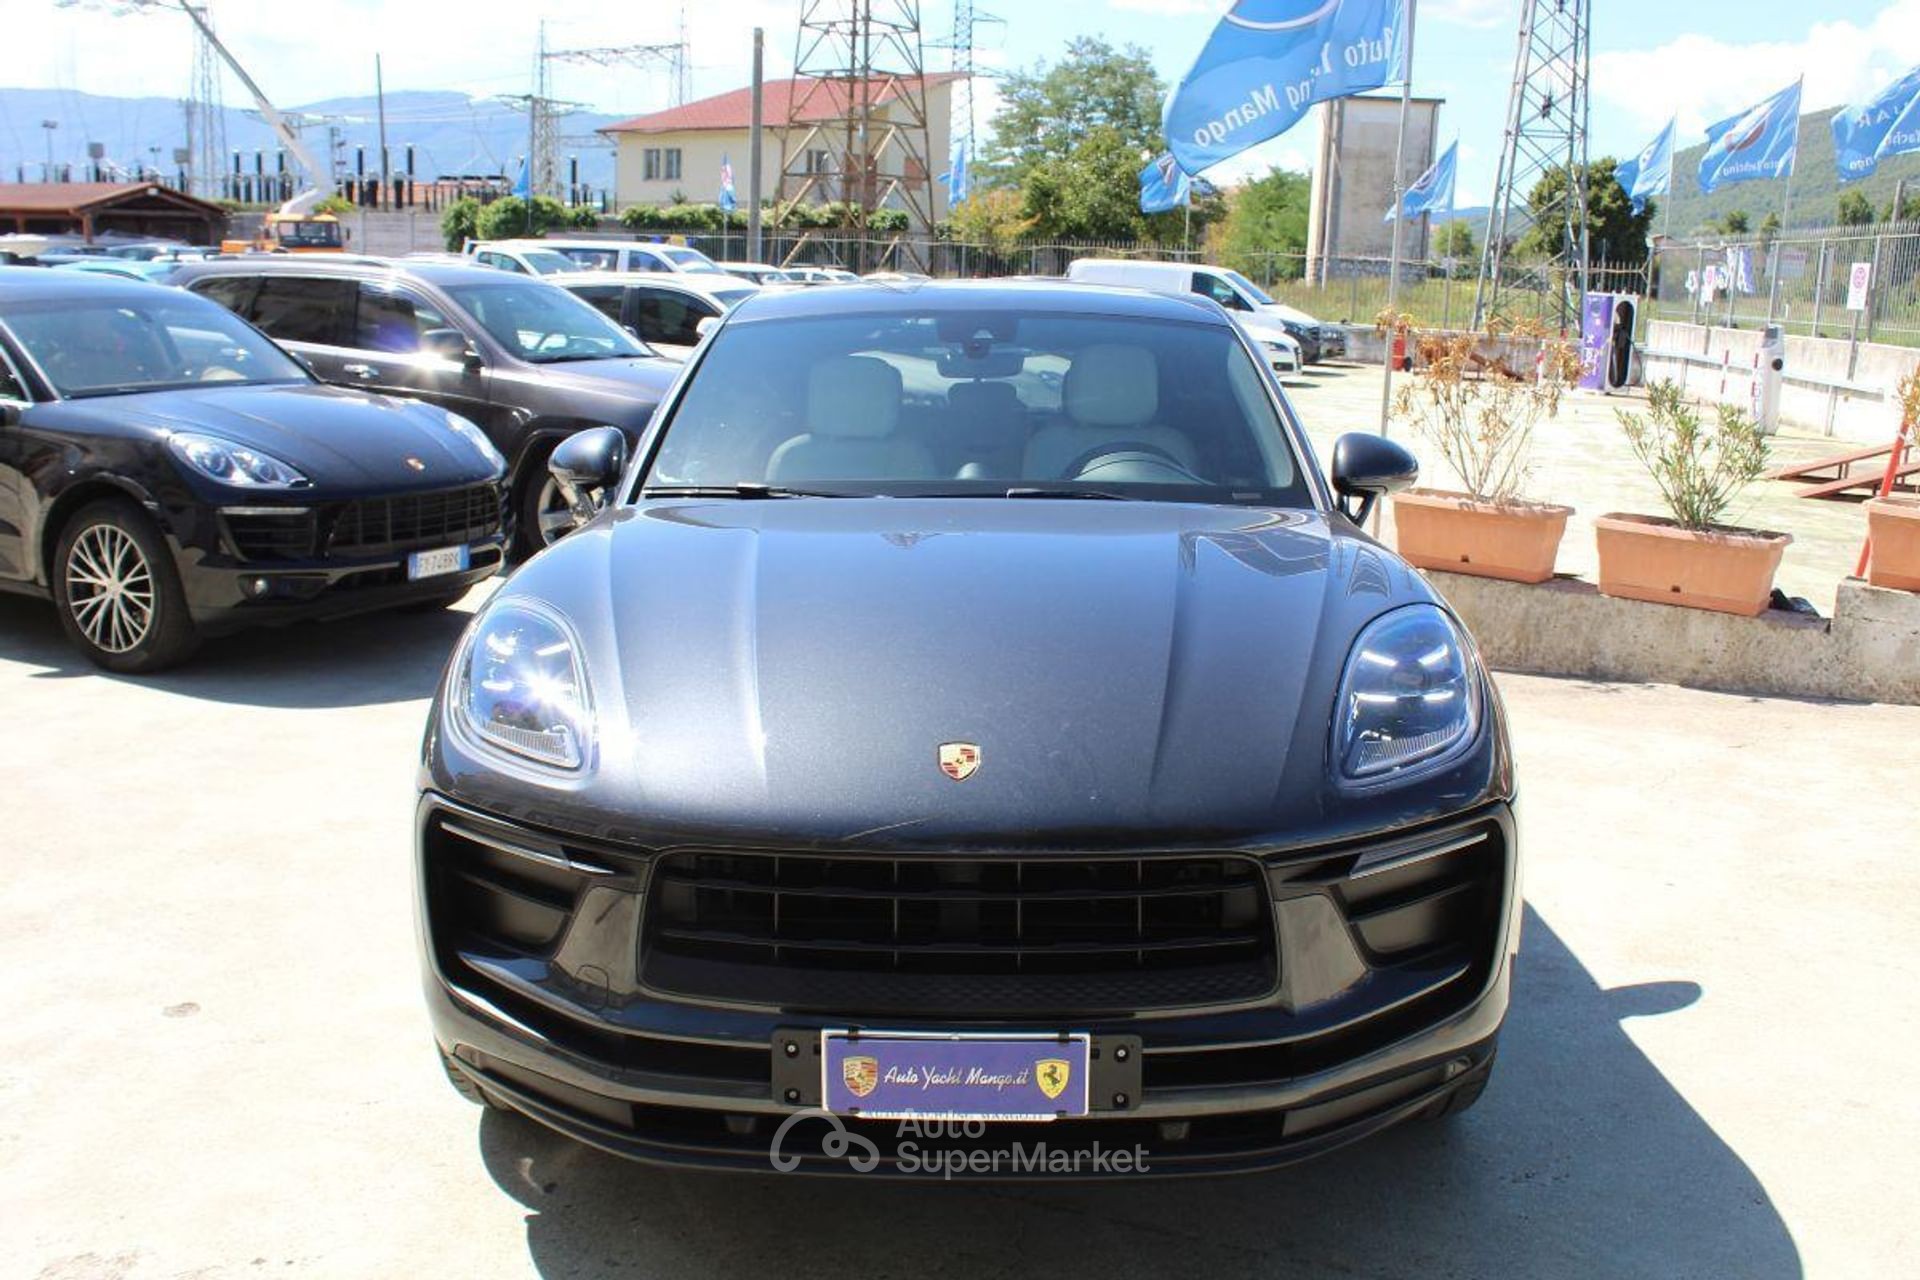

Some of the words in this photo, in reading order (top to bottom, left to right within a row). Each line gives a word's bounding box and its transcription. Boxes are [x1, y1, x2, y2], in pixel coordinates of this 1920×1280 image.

[883, 1065, 919, 1085] Auto
[921, 1065, 962, 1091] Yacht
[965, 1067, 1030, 1091] Mango.it
